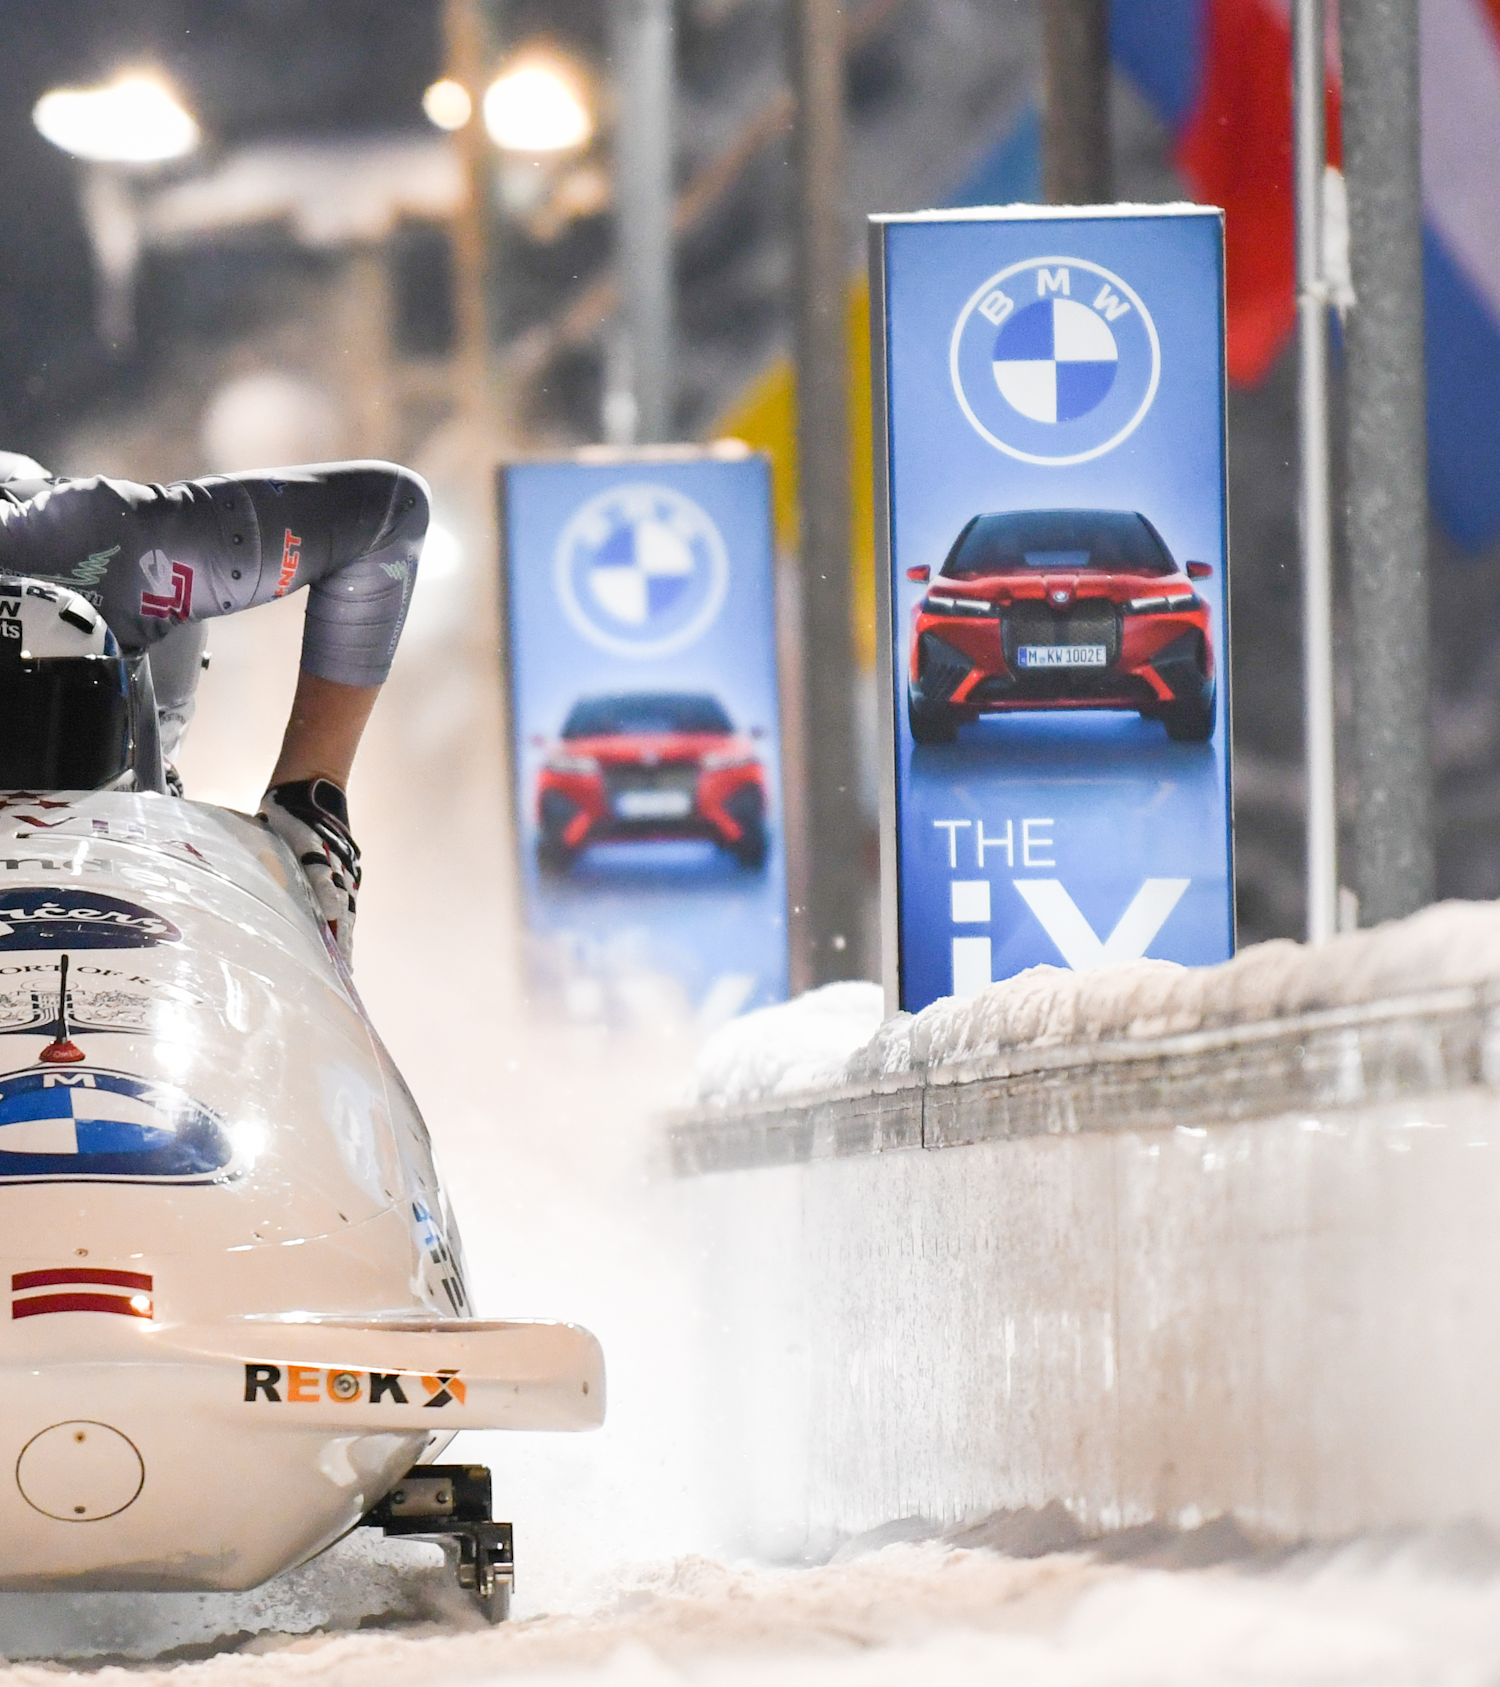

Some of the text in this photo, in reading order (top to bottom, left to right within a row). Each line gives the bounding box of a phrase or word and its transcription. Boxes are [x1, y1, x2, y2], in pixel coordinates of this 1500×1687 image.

[978, 267, 1131, 326] BMW
[933, 818, 1056, 868] THE
[77, 965, 122, 978] OF
